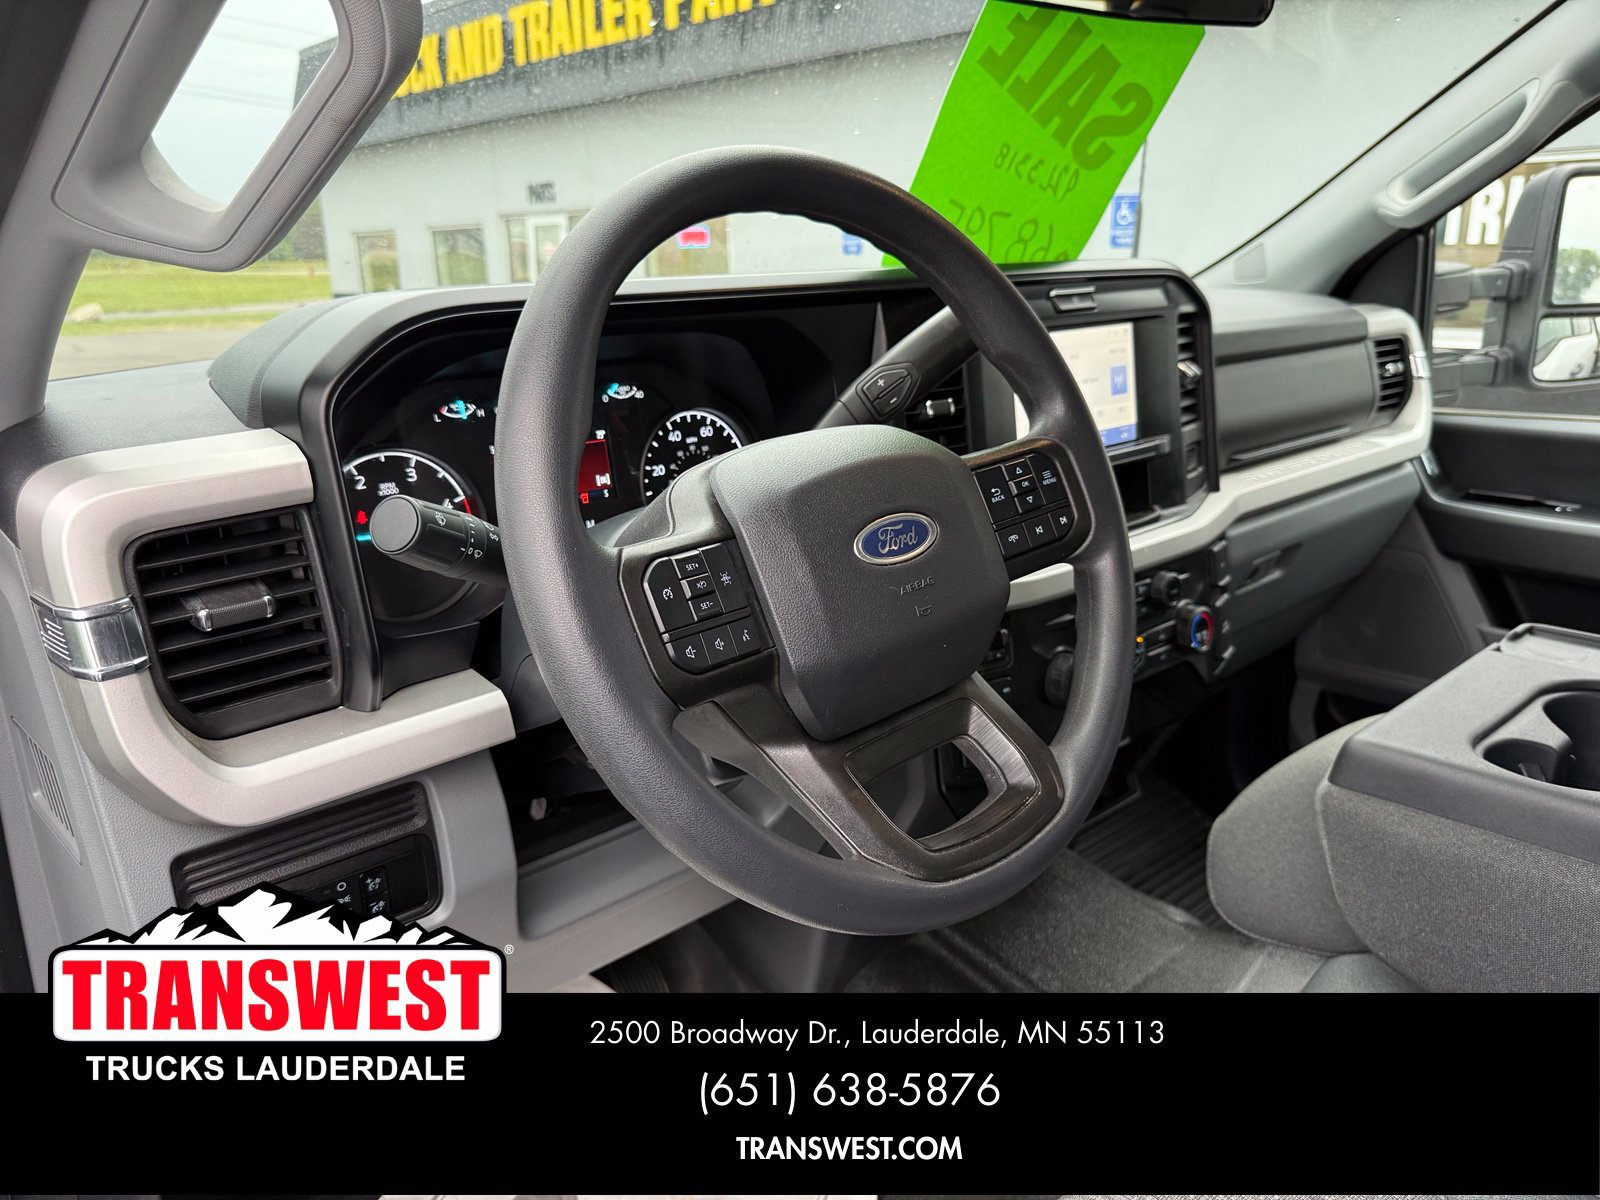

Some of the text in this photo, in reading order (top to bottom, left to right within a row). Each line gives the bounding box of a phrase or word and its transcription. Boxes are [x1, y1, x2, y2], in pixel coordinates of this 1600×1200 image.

[445, 13, 505, 85] AND
[507, 0, 655, 67] TRAILER
[668, 430, 682, 443] 40
[700, 425, 714, 438] 60
[405, 467, 418, 482] 3
[651, 464, 666, 477] 20
[354, 475, 367, 490] 2
[378, 481, 395, 490] RPM
[1042, 477, 1057, 486] MENU
[991, 494, 1006, 503] BACK
[878, 523, 919, 555] Ford
[685, 563, 699, 571] SET+
[900, 576, 935, 596] AIRBAG
